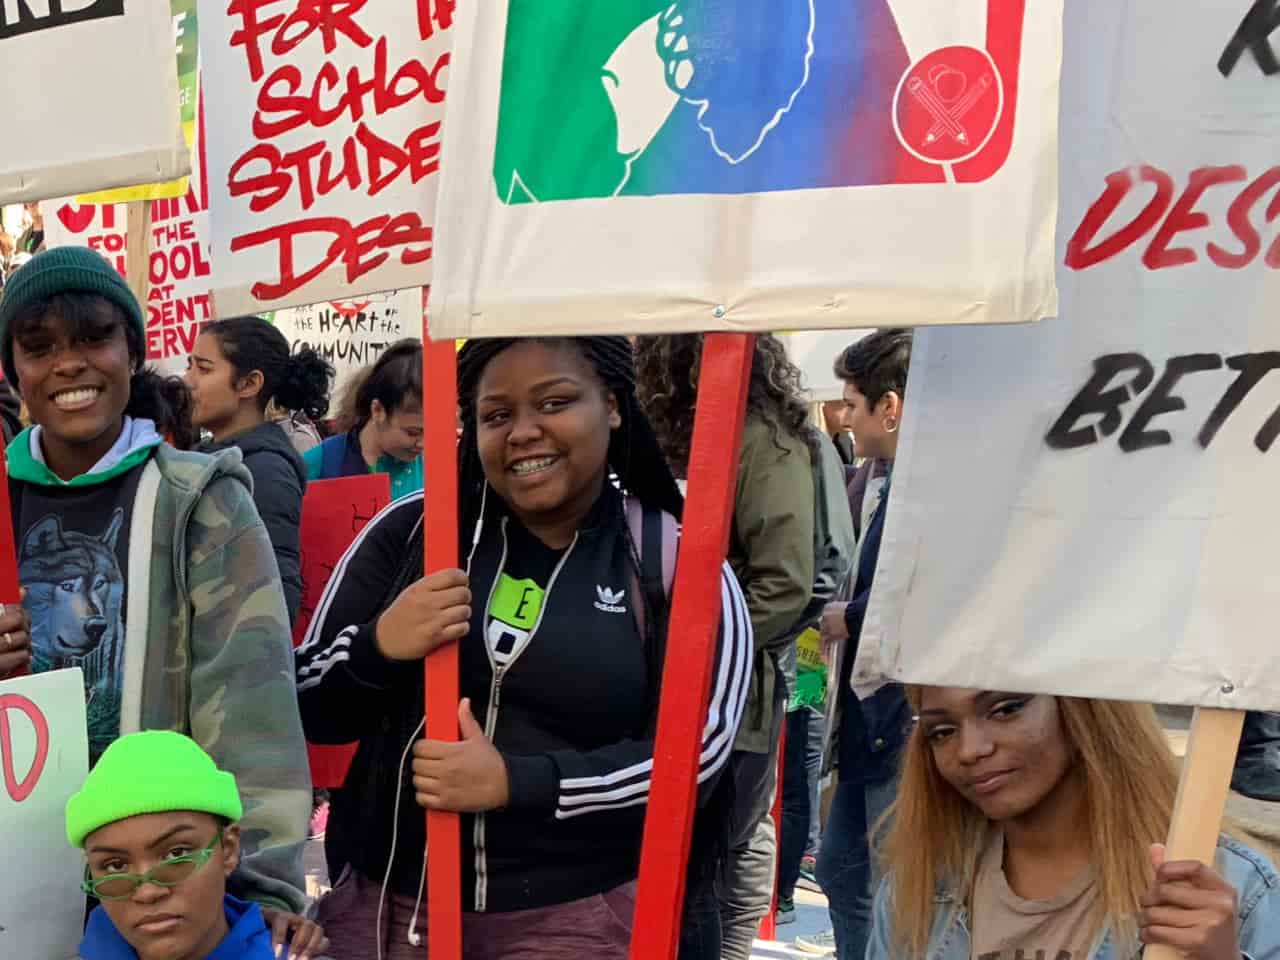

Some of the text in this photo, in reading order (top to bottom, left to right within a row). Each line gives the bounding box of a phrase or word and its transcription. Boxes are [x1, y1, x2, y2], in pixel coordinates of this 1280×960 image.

[226, 0, 374, 82] FOR
[226, 121, 442, 213] STUDE
[88, 221, 197, 253] FO THE
[1063, 164, 1280, 270] DES
[146, 321, 209, 361] ERV
[593, 601, 627, 613] adidas
